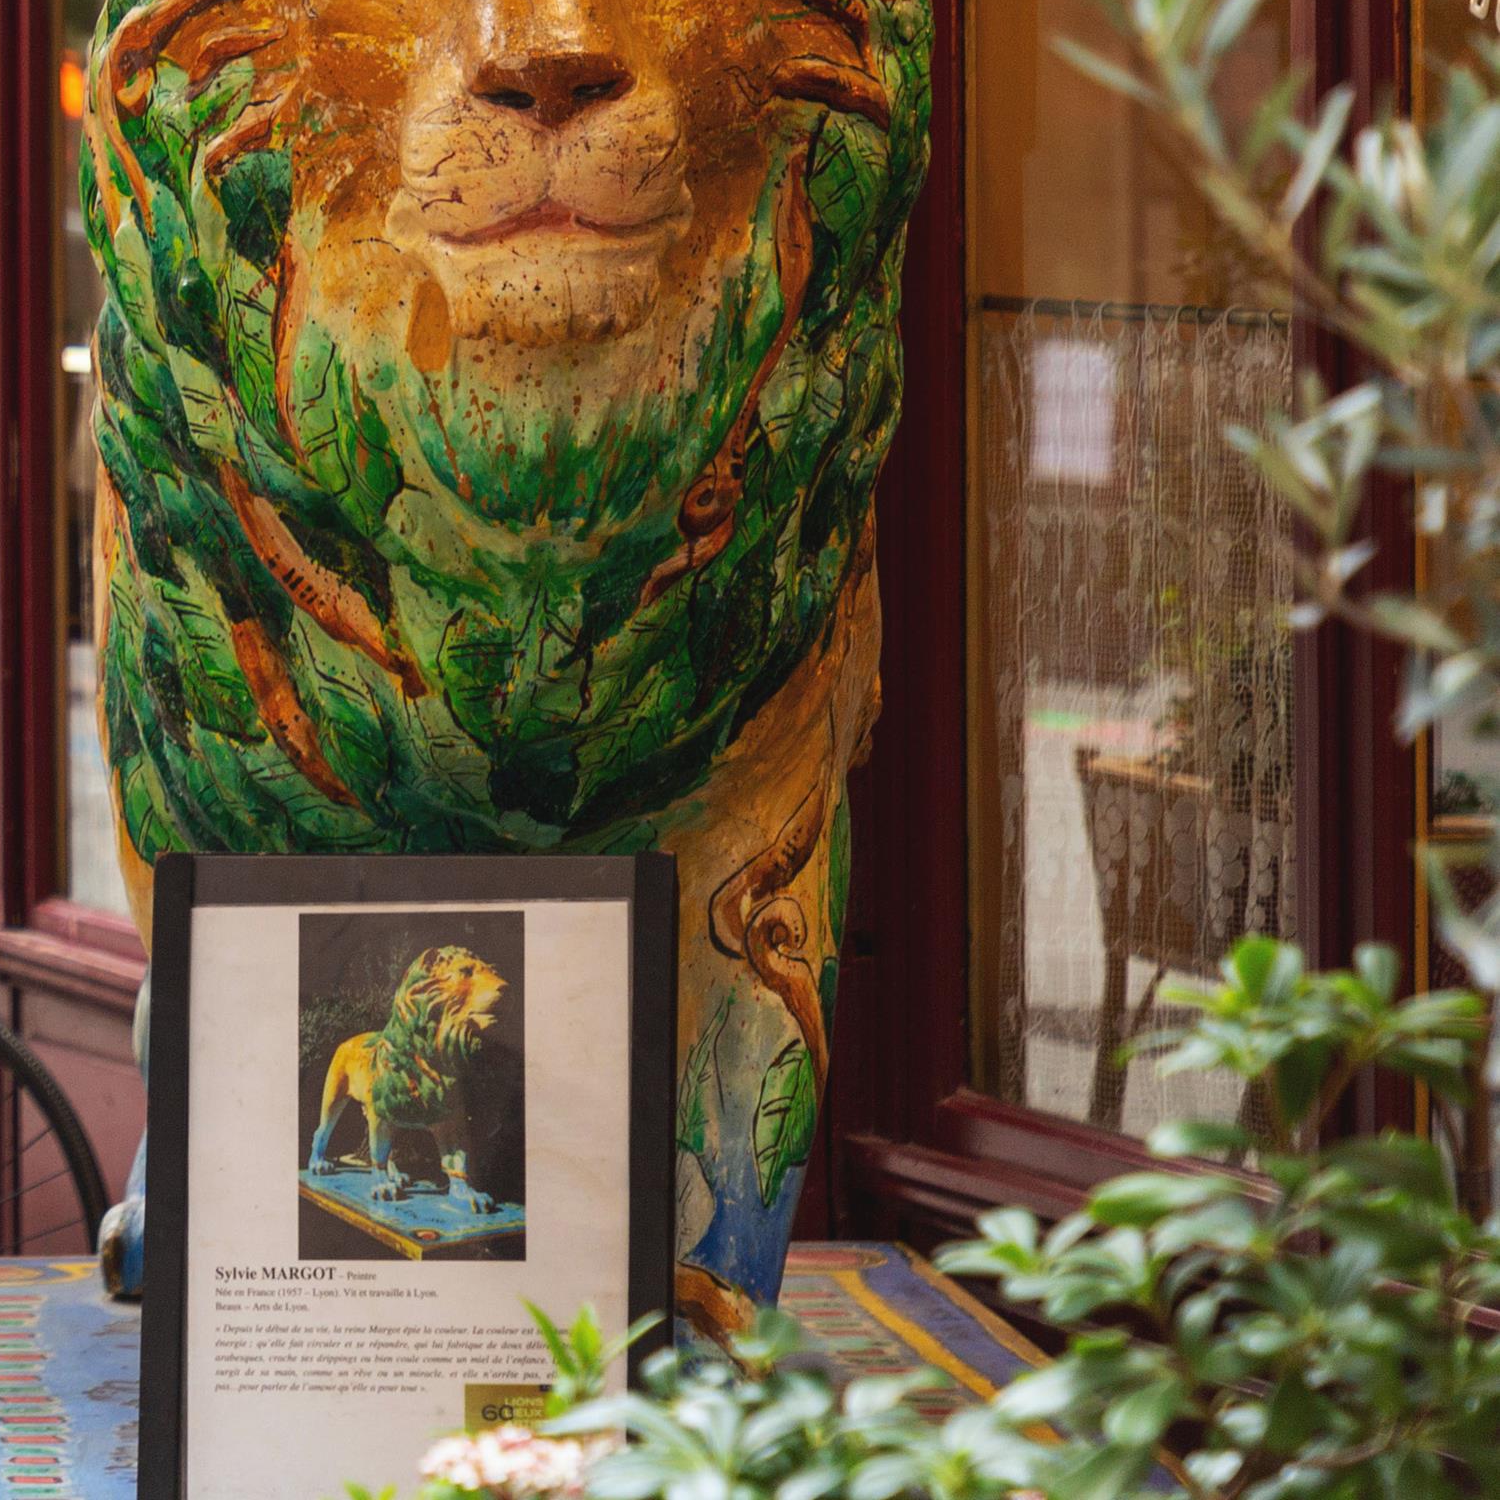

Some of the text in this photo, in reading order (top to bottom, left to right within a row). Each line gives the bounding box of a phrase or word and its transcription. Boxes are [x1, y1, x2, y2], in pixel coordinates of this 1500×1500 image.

[215, 1266, 258, 1284] Sylvie
[262, 1266, 336, 1280] MARGOT
[346, 1272, 377, 1281] Peintre
[215, 1287, 232, 1297] Née
[247, 1288, 276, 1297] France
[277, 1287, 302, 1299] (1957
[344, 1288, 358, 1298] Vit
[369, 1288, 404, 1298] travaille
[413, 1289, 438, 1300] Lyon.
[215, 1302, 242, 1310] Beaux
[252, 1302, 270, 1311] Arts
[284, 1302, 310, 1314] Lyon.
[222, 1324, 253, 1335] Depuis
[265, 1324, 289, 1333] début
[345, 1326, 366, 1334] reine
[369, 1325, 400, 1335] Margot
[486, 1326, 519, 1335] couleur
[215, 1339, 247, 1350] énergie
[288, 1339, 303, 1349] fait
[306, 1339, 341, 1348] circuler
[414, 1341, 428, 1350] qui
[432, 1340, 443, 1348] lui
[446, 1340, 483, 1351] fabrique
[501, 1341, 522, 1349] doux
[214, 1353, 265, 1364] arabesques,
[316, 1354, 357, 1364] drippings
[374, 1355, 393, 1363] bien
[396, 1355, 419, 1363] coule
[470, 1356, 489, 1364] miel
[215, 1368, 240, 1378] surgit
[354, 1369, 372, 1377] rêve
[462, 1369, 478, 1378] elle
[260, 1382, 287, 1393] parler
[377, 1385, 398, 1394] pour
[400, 1384, 418, 1392] tout
[504, 1396, 544, 1406] LIONS
[482, 1404, 514, 1421] 60
